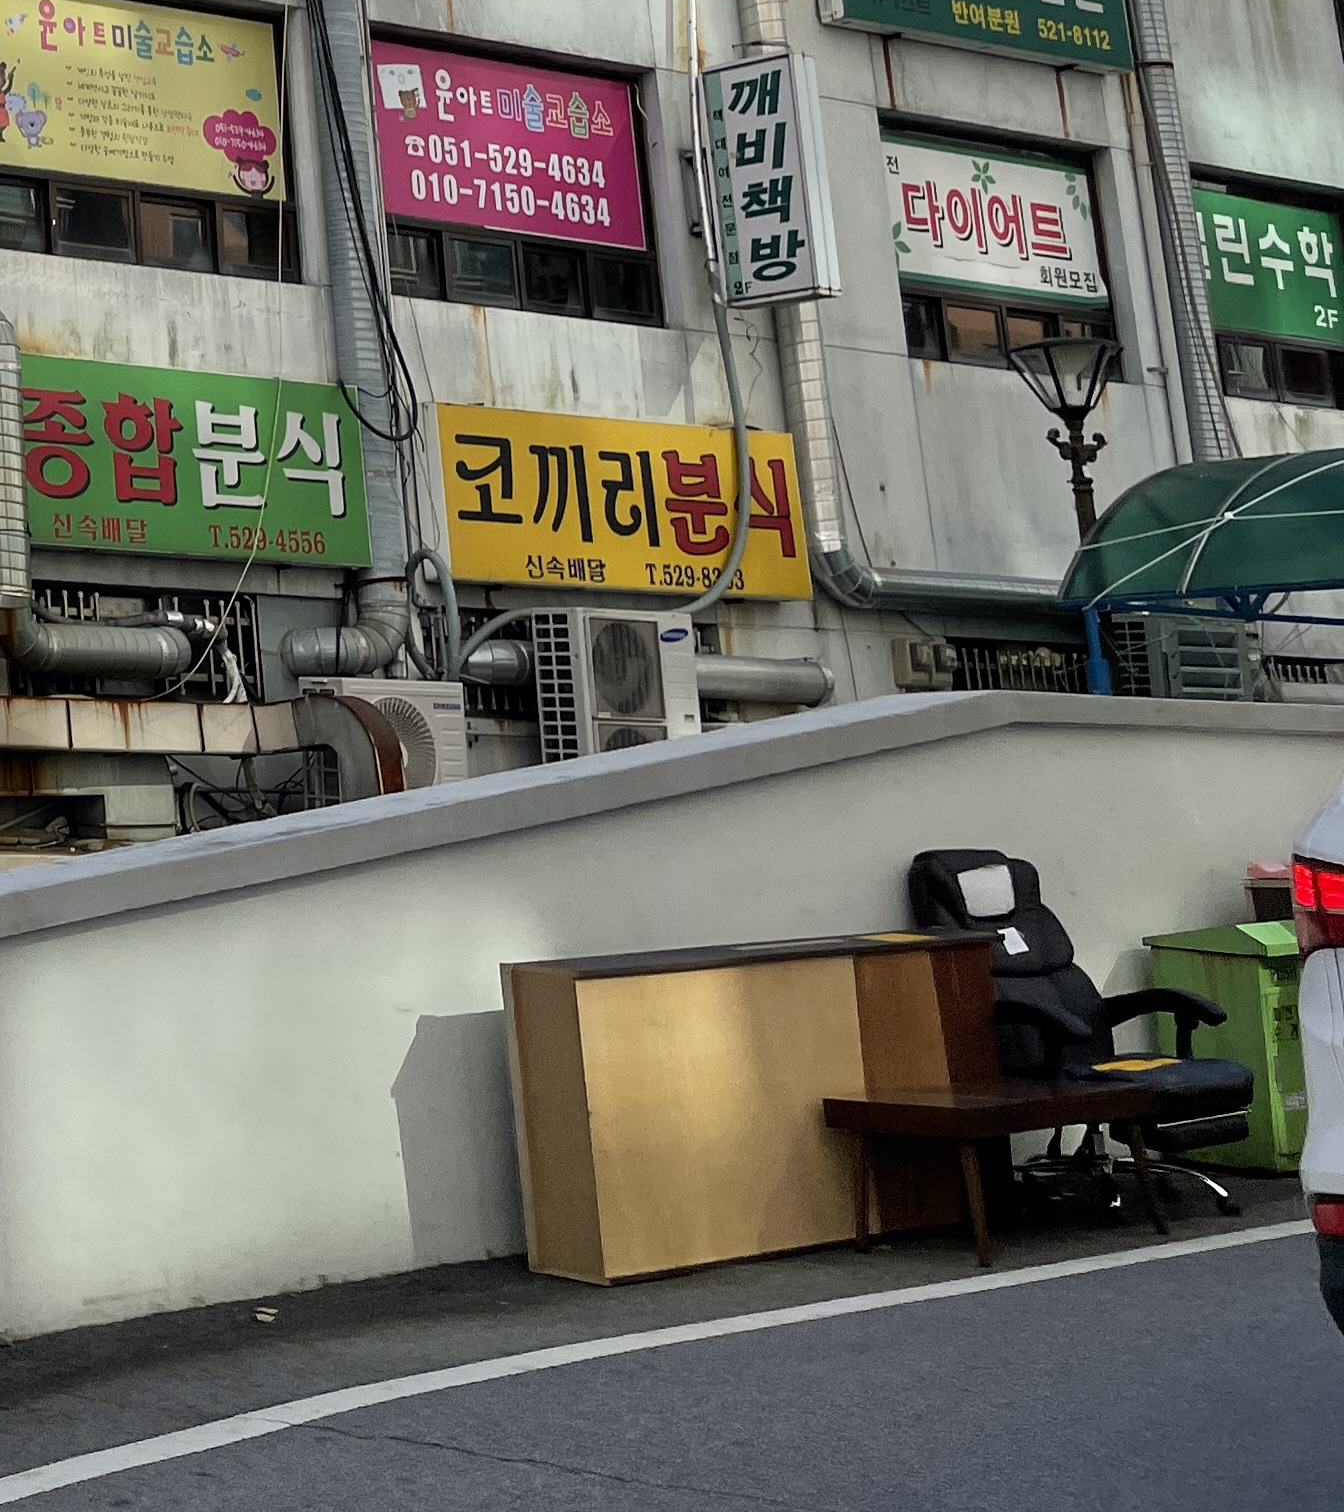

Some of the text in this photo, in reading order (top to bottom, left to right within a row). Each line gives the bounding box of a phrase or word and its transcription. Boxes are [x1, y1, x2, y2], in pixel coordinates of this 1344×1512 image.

[37, 0, 215, 67] 윤아트미술교습소
[1037, 17, 1112, 50] 521-8112
[434, 68, 614, 140] 윤아트미술교습소
[428, 134, 606, 189] 051-529-4634
[728, 69, 805, 281] 깨비책방
[411, 168, 612, 227] 010-7150-4634
[900, 179, 1074, 262] 다이어트
[1039, 264, 1099, 294] 회원모집
[1313, 304, 1339, 330] 2F
[454, 433, 797, 559] 코끼리분식
[51, 513, 327, 556] 신속배달 T.529-4556
[524, 554, 745, 590] 신속배달 T.529-823
